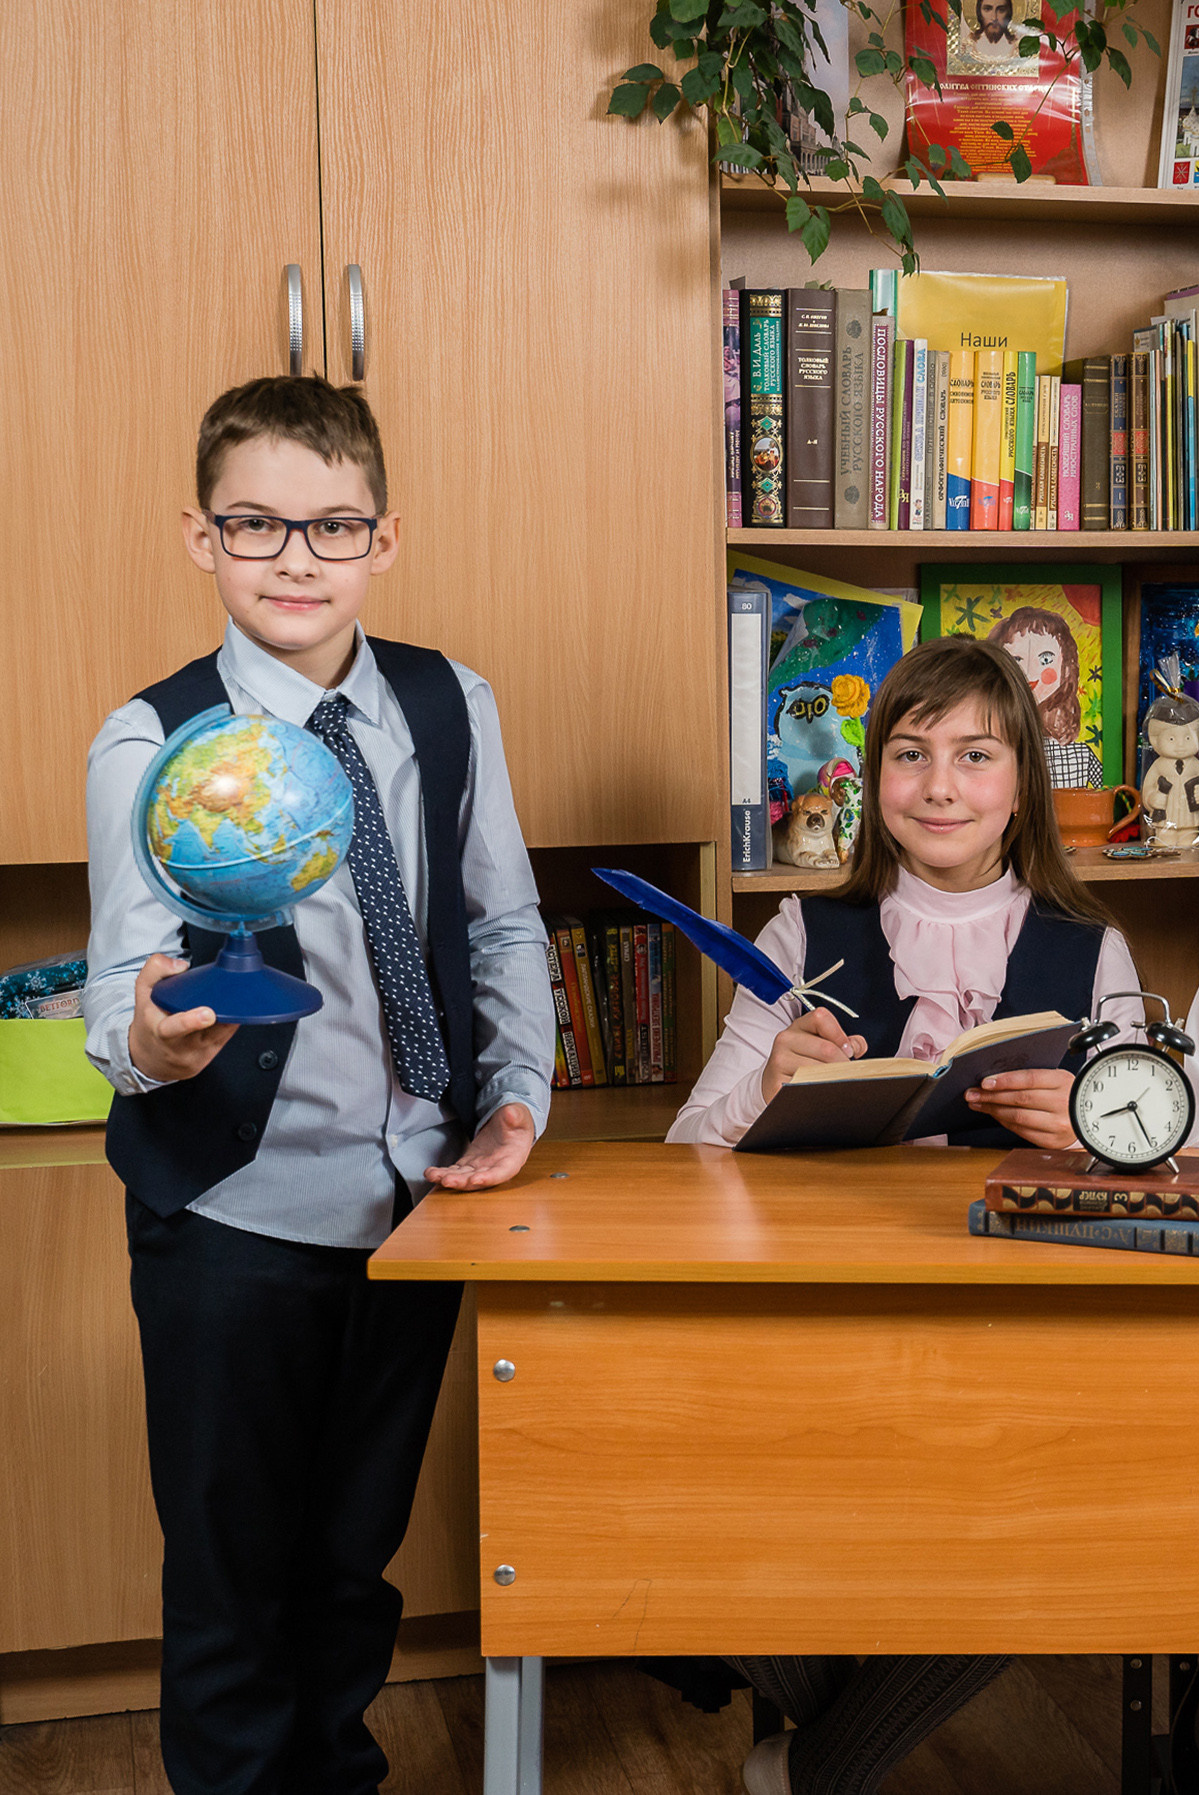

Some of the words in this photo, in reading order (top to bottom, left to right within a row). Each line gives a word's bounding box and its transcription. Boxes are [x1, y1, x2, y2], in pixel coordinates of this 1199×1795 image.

[960, 332, 1008, 348] Наши
[762, 352, 770, 392] ТОЛКОВЫЙ
[841, 346, 853, 406] СЛОВАРЬ
[853, 352, 864, 399] ЯЗЫКА
[876, 328, 887, 404] ПОСЛОВИЦЫ
[916, 348, 926, 384] СЛОВА
[1005, 371, 1016, 405] СЛОВАРЬ
[1063, 394, 1071, 430] СЛОВАРЬ
[839, 410, 852, 476] УЧЕБНЫЙ
[852, 401, 864, 471] РУССКОГО
[875, 407, 886, 468] РУССКОГО
[1070, 419, 1078, 478] ИНОСТРАННЫХ
[1062, 432, 1070, 478] НОВЕЙШИЙ
[874, 473, 886, 519] НАРОДА
[742, 810, 751, 863] ErichKrause
[1107, 1065, 1118, 1079] 11
[1126, 1058, 1139, 1072] 12
[1150, 1064, 1156, 1077] 1
[1092, 1080, 1104, 1093] 10
[1165, 1080, 1173, 1092] 2
[1084, 1100, 1093, 1112] 9
[1172, 1100, 1180, 1113] 3
[1092, 1121, 1100, 1133] 8
[1165, 1121, 1173, 1133] 4
[1108, 1135, 1116, 1147] 7
[1128, 1141, 1136, 1154] 6
[1150, 1136, 1158, 1148] 5
[1078, 1191, 1108, 1201] КУПЕР
